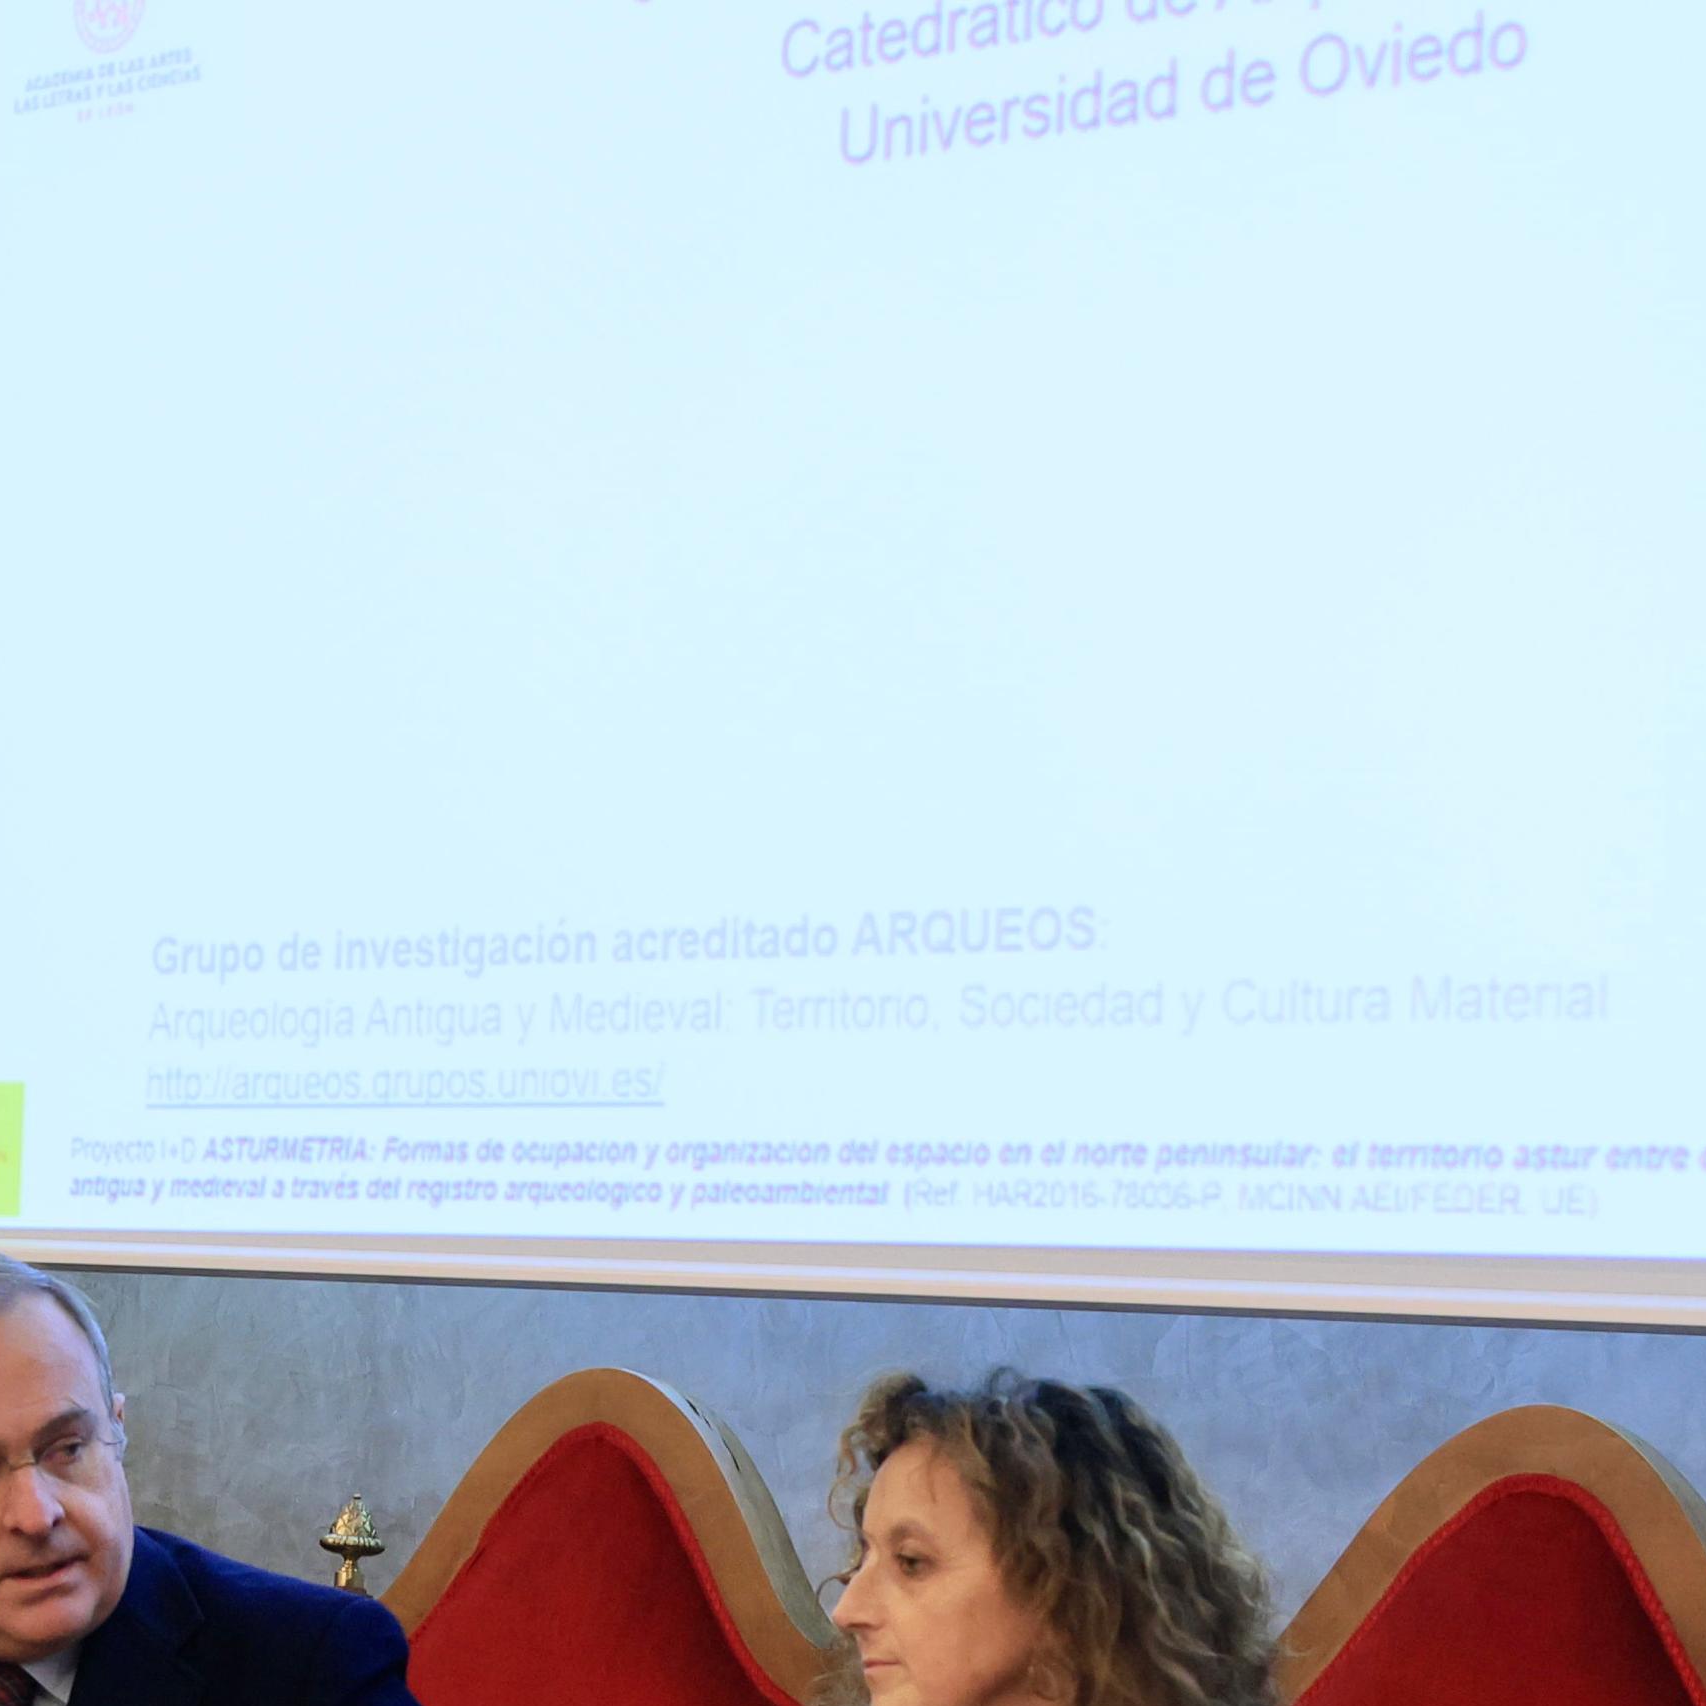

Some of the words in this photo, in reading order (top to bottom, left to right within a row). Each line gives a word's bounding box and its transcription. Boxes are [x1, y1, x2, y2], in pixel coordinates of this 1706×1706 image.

[840, 57, 1181, 164] Universidad
[1200, 46, 1278, 112] de
[1298, 10, 1531, 97] Oviedo
[151, 934, 266, 985] Grupo
[278, 929, 323, 972] de
[334, 916, 598, 978] investigación
[612, 914, 839, 963] acreditado
[364, 996, 502, 1046] Antigua
[515, 1001, 538, 1046] y
[957, 980, 1165, 1031] Sociedad
[1180, 988, 1207, 1037] y
[1221, 976, 1392, 1027] Cultura
[1408, 973, 1611, 1025] Material
[70, 1136, 157, 1168] Proyecto
[382, 1136, 470, 1165] Formas
[476, 1138, 505, 1164] de
[643, 1142, 661, 1171] y
[838, 1139, 880, 1166] del
[886, 1140, 992, 1172] espacio
[998, 1142, 1032, 1166] en
[1039, 1140, 1065, 1167] el
[1073, 1142, 1150, 1168] norte
[1331, 1140, 1358, 1169] el
[1368, 1141, 1502, 1169] territorio
[1514, 1142, 1600, 1171] astur
[1606, 1145, 1692, 1171] entre
[69, 1174, 146, 1205] antigua
[150, 1177, 167, 1205] y
[169, 1173, 267, 1201] medieval
[271, 1177, 286, 1200] a
[291, 1171, 360, 1201] través
[366, 1174, 401, 1201] del
[406, 1174, 499, 1208] registro
[667, 1182, 687, 1211] y
[691, 1179, 891, 1211] paleoambiental
